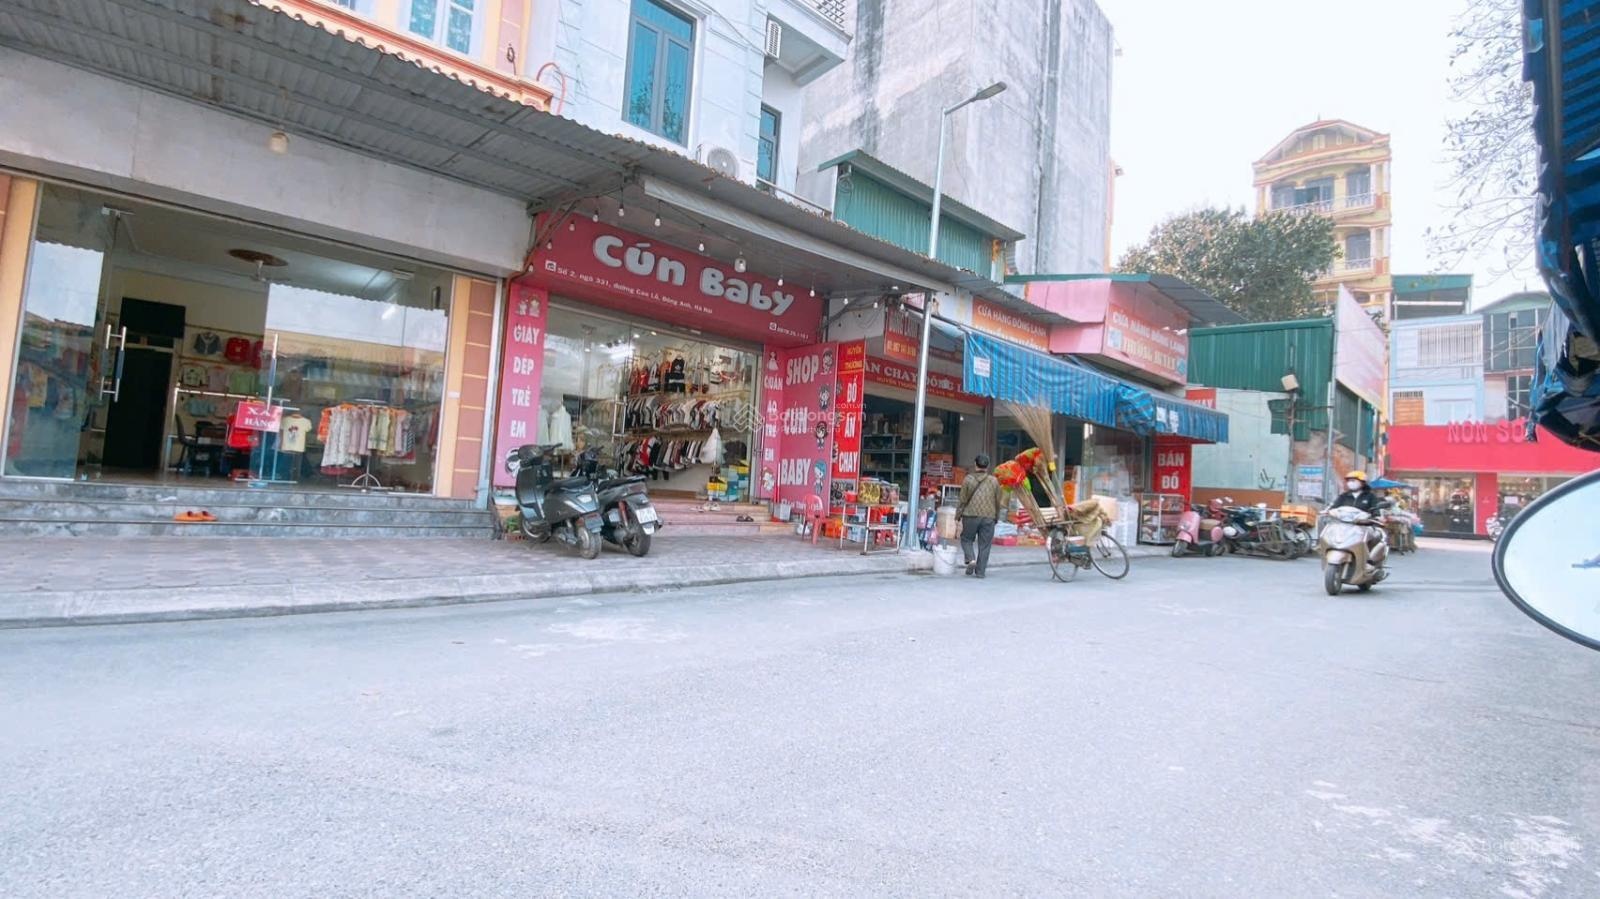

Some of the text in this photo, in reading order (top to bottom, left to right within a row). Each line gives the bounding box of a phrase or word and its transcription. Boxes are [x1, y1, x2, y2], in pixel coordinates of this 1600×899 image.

[593, 235, 795, 316] Cún Baby
[786, 354, 820, 386] SHOP
[510, 420, 526, 438] EM
[1447, 414, 1488, 443] NÓN
[780, 458, 812, 486] BABY
[838, 451, 859, 473] CHAY
[1157, 450, 1185, 467] BÁN
